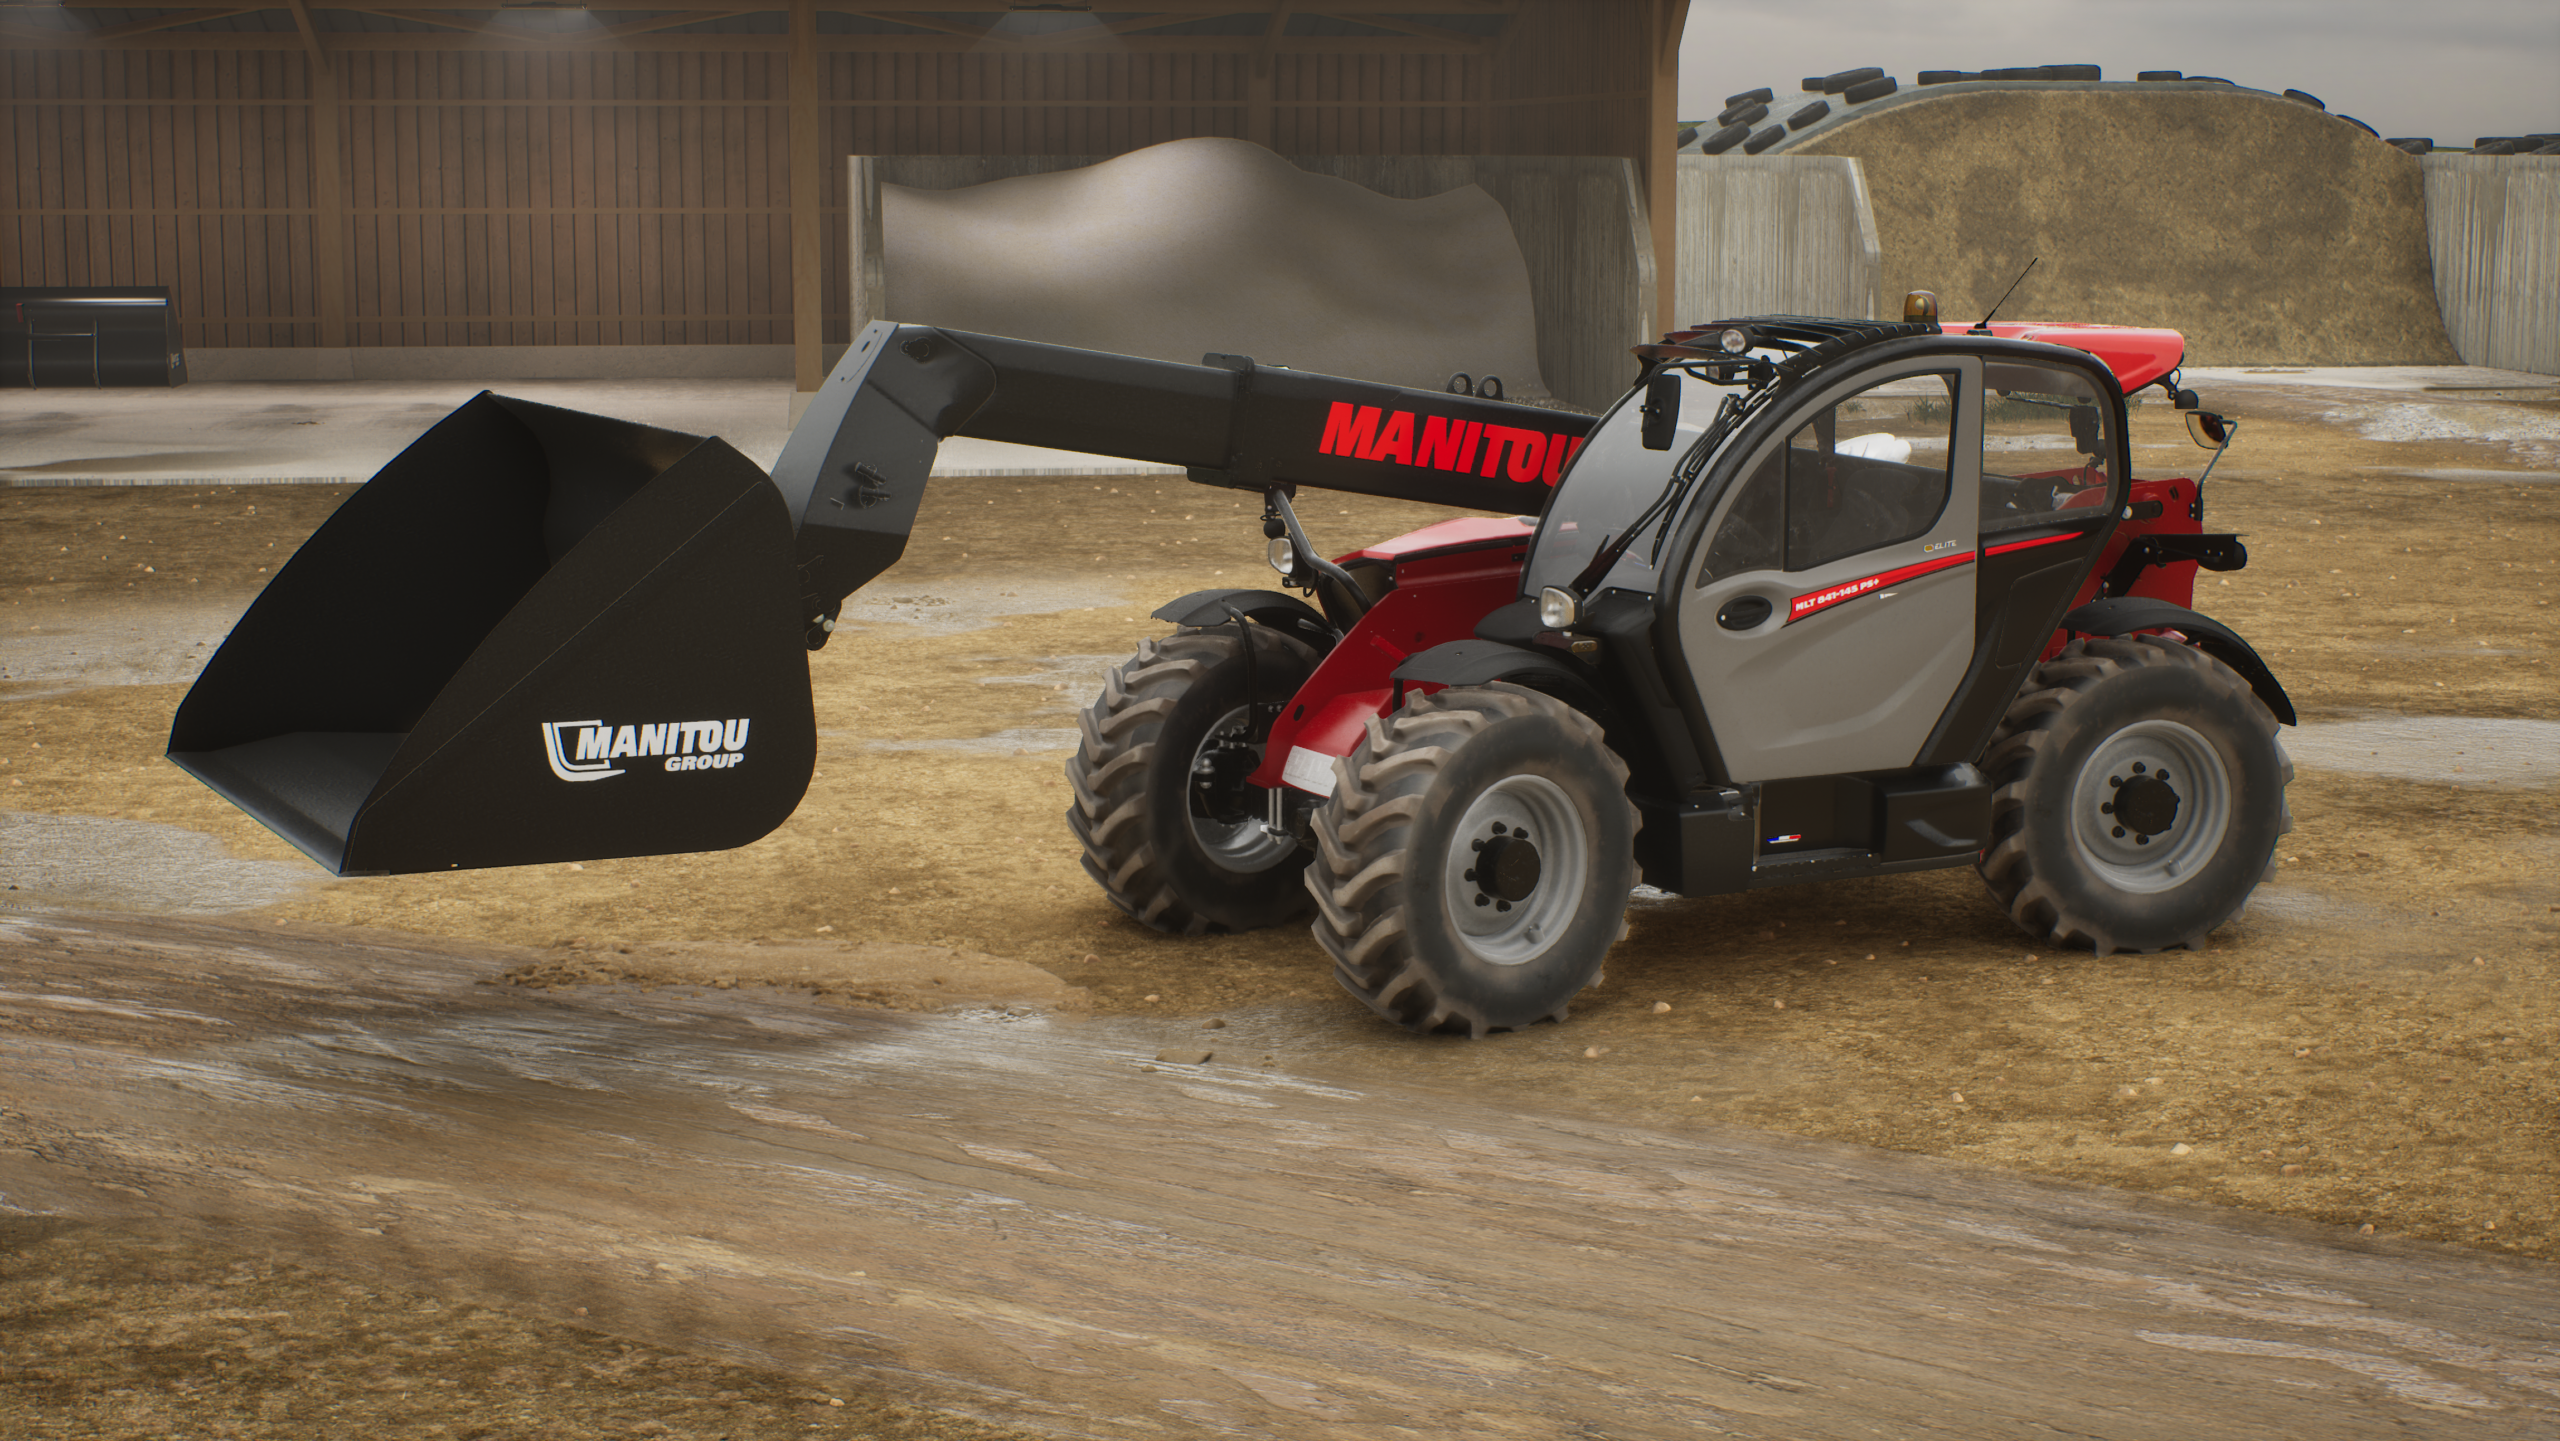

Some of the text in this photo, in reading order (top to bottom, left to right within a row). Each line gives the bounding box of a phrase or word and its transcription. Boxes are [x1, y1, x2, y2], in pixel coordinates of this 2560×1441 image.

[1934, 540, 1957, 550] ELITE
[1795, 578, 1879, 611] MLT 841-145 PS+
[575, 718, 750, 761] MANITOU
[664, 753, 744, 772] GROUP
